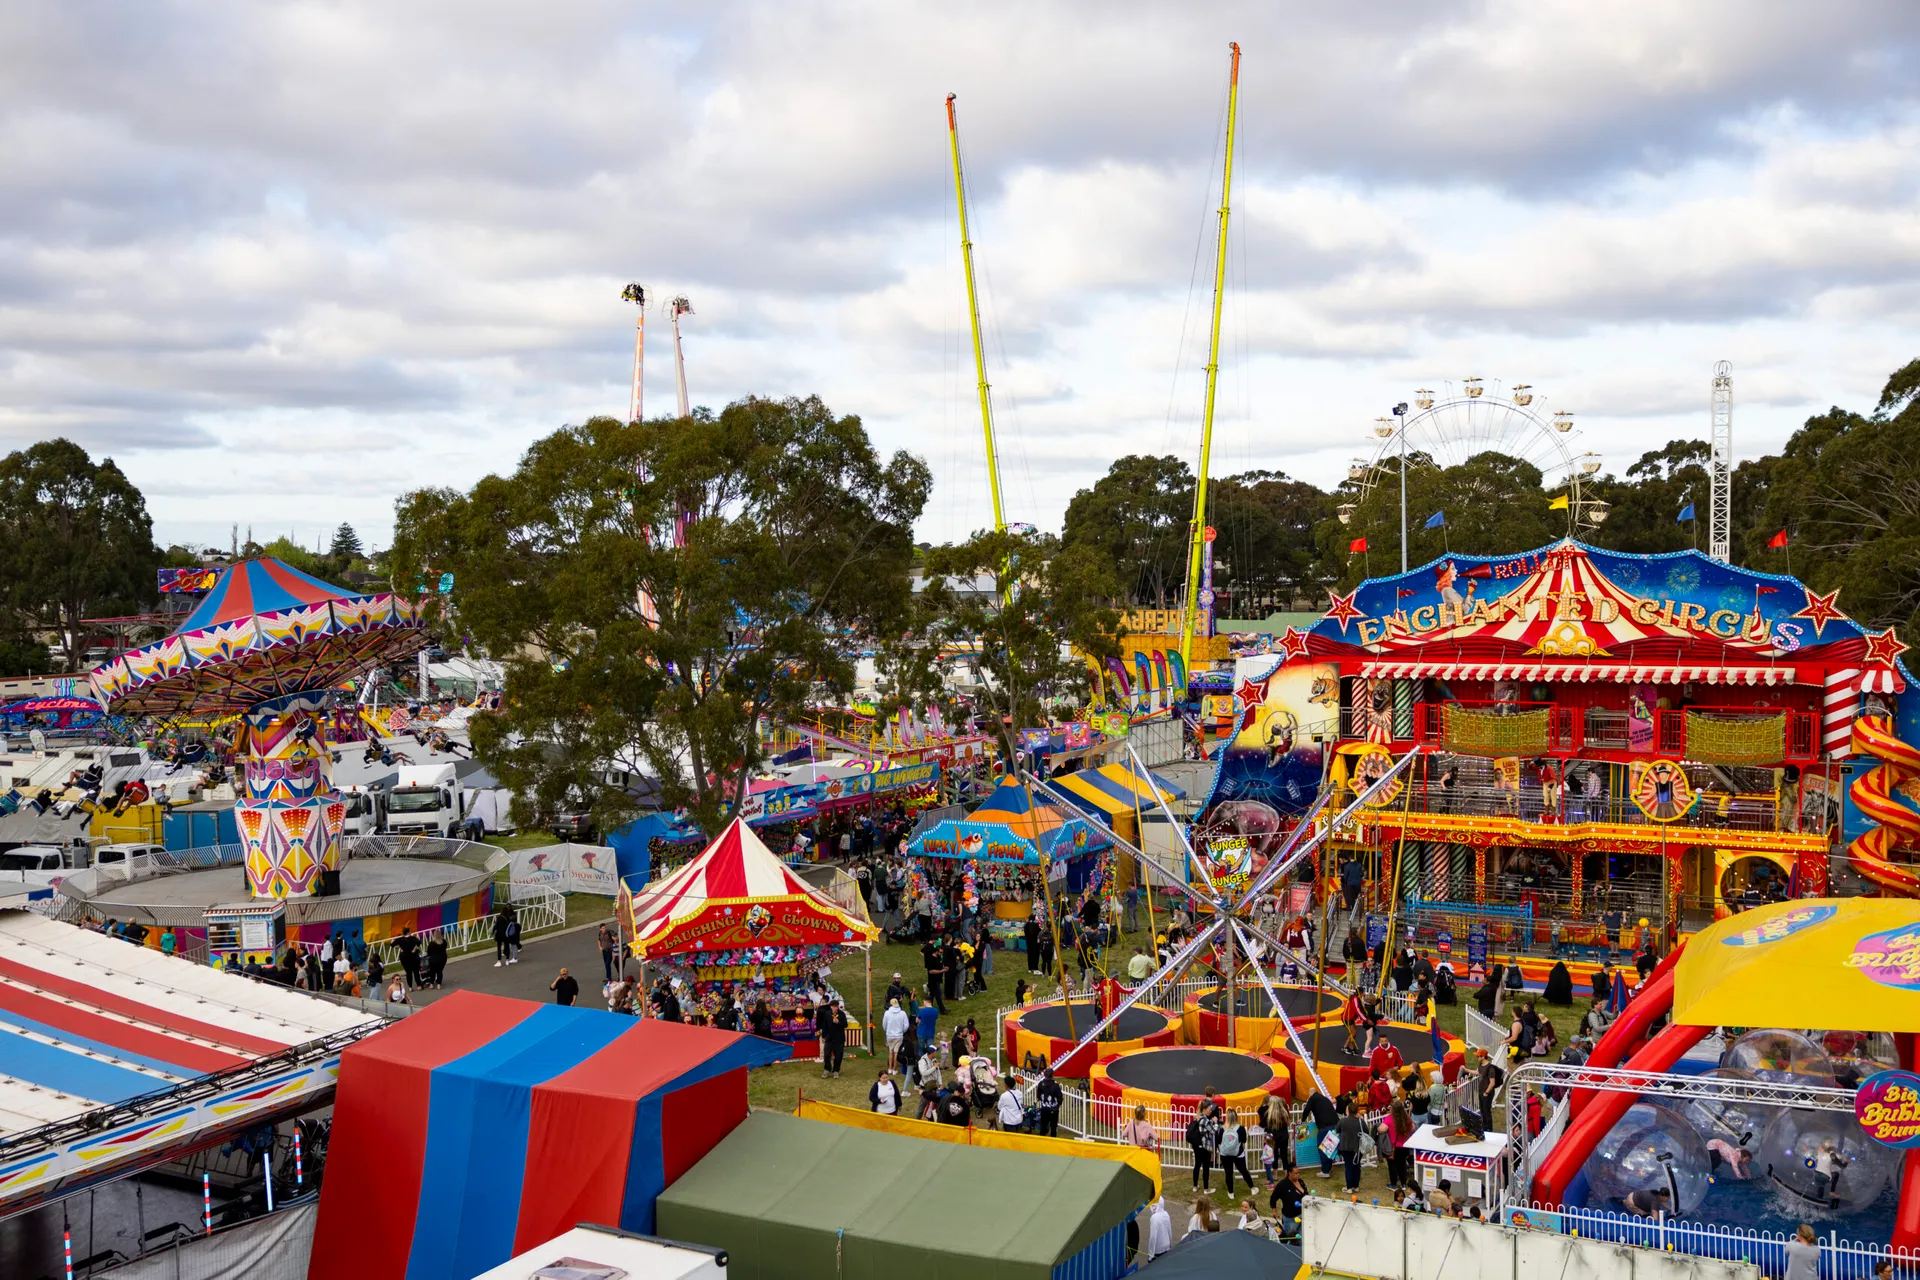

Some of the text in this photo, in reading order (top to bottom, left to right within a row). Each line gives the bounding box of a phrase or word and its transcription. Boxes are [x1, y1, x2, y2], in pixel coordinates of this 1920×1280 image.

[1356, 594, 1804, 652] ENCHANTED CIRCUS
[875, 765, 933, 789] BIG WINNERS
[923, 838, 957, 855] LUCKY
[1210, 838, 1248, 852] FUNGEE
[1211, 872, 1249, 887] BUNGEE
[664, 914, 736, 950] LAUGHING
[781, 912, 842, 934] CLOWNS
[1883, 1085, 1919, 1108] Big
[1419, 1150, 1483, 1168] TICKETS
